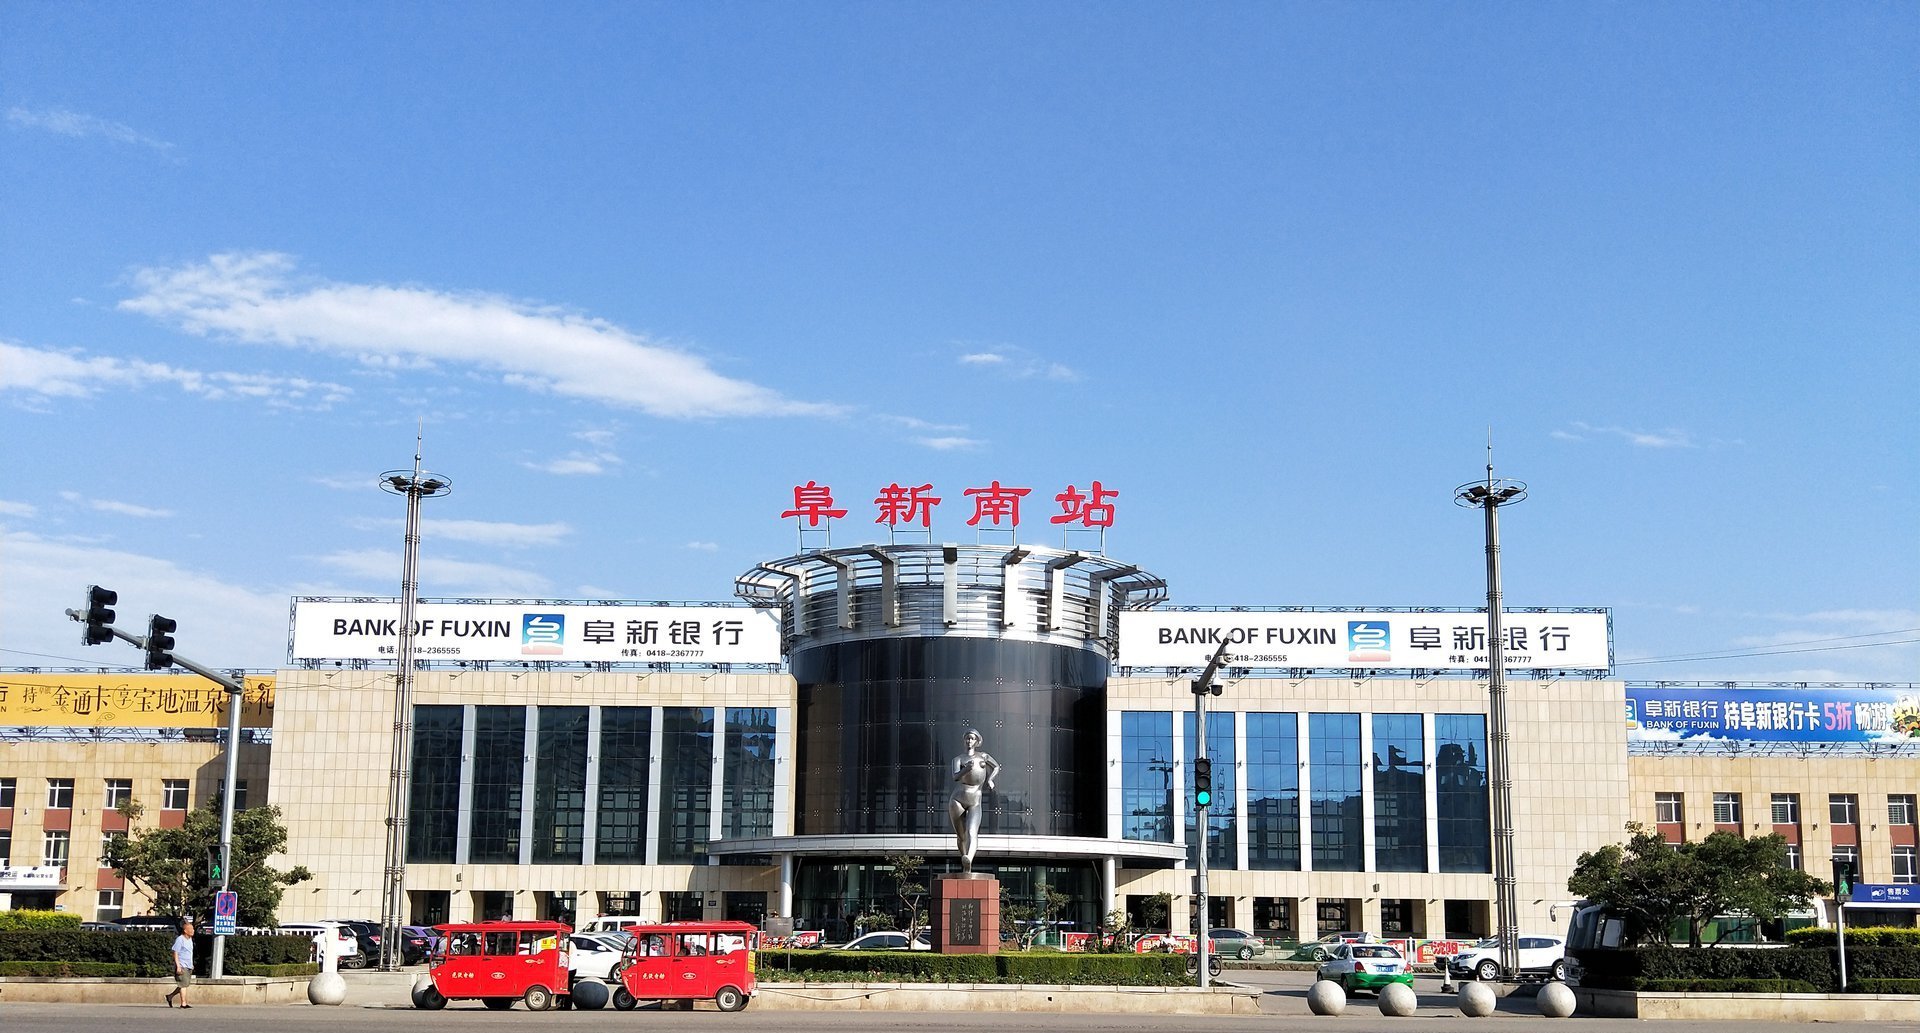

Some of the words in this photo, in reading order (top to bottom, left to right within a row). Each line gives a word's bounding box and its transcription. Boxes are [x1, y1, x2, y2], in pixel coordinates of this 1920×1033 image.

[781, 480, 1119, 527] 阜新南站
[333, 618, 397, 636] BANK
[441, 620, 511, 638] FUXIN
[583, 619, 744, 645] 阜新银行
[1158, 627, 1222, 644] BANK
[1229, 627, 1259, 644] OF
[1266, 627, 1336, 645] FUXIN
[646, 649, 704, 658] 0418-2367777
[1234, 654, 1288, 662] 418-2365555
[1645, 700, 1719, 718] 阜新银行
[1646, 720, 1674, 729] BANK
[1675, 720, 1689, 729] OF
[1691, 721, 1720, 729] FUXIN
